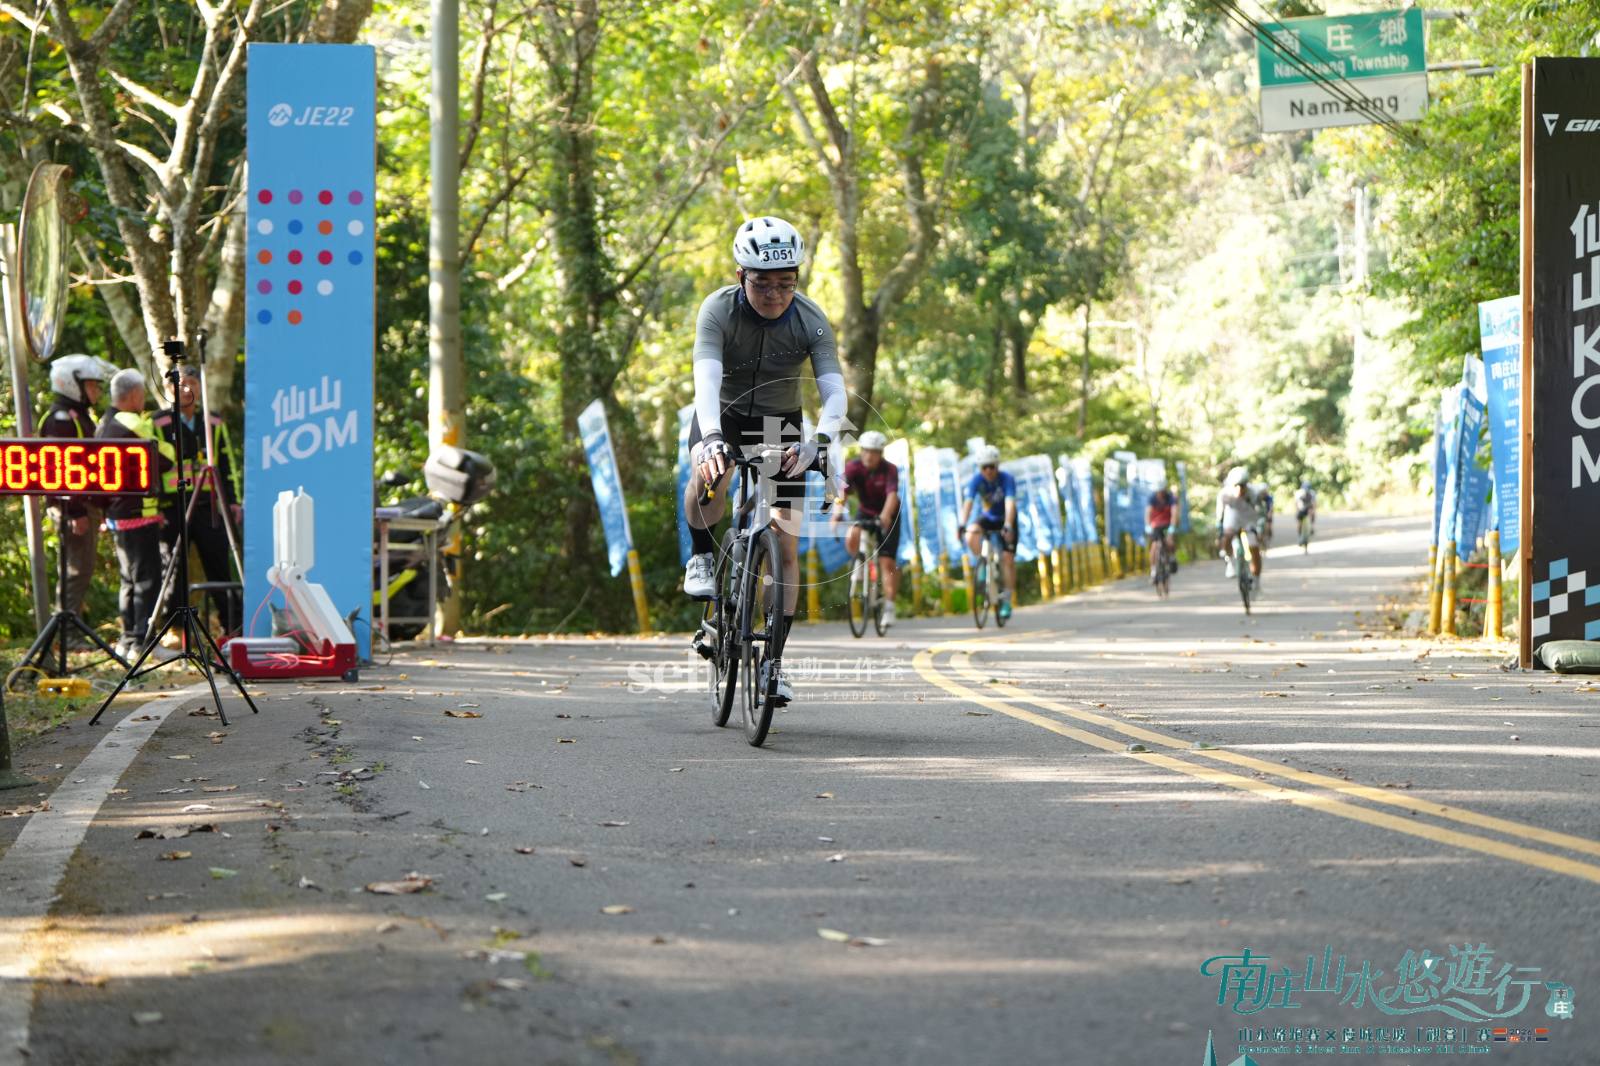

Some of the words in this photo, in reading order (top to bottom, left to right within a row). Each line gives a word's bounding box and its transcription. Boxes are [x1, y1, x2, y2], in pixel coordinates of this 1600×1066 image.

[1350, 55, 1409, 72] Township
[294, 106, 354, 126] JE22
[762, 249, 794, 262] 3051
[271, 375, 341, 428] 仙山
[262, 409, 358, 471] KOM
[0, 445, 148, 490] 8:06:07
